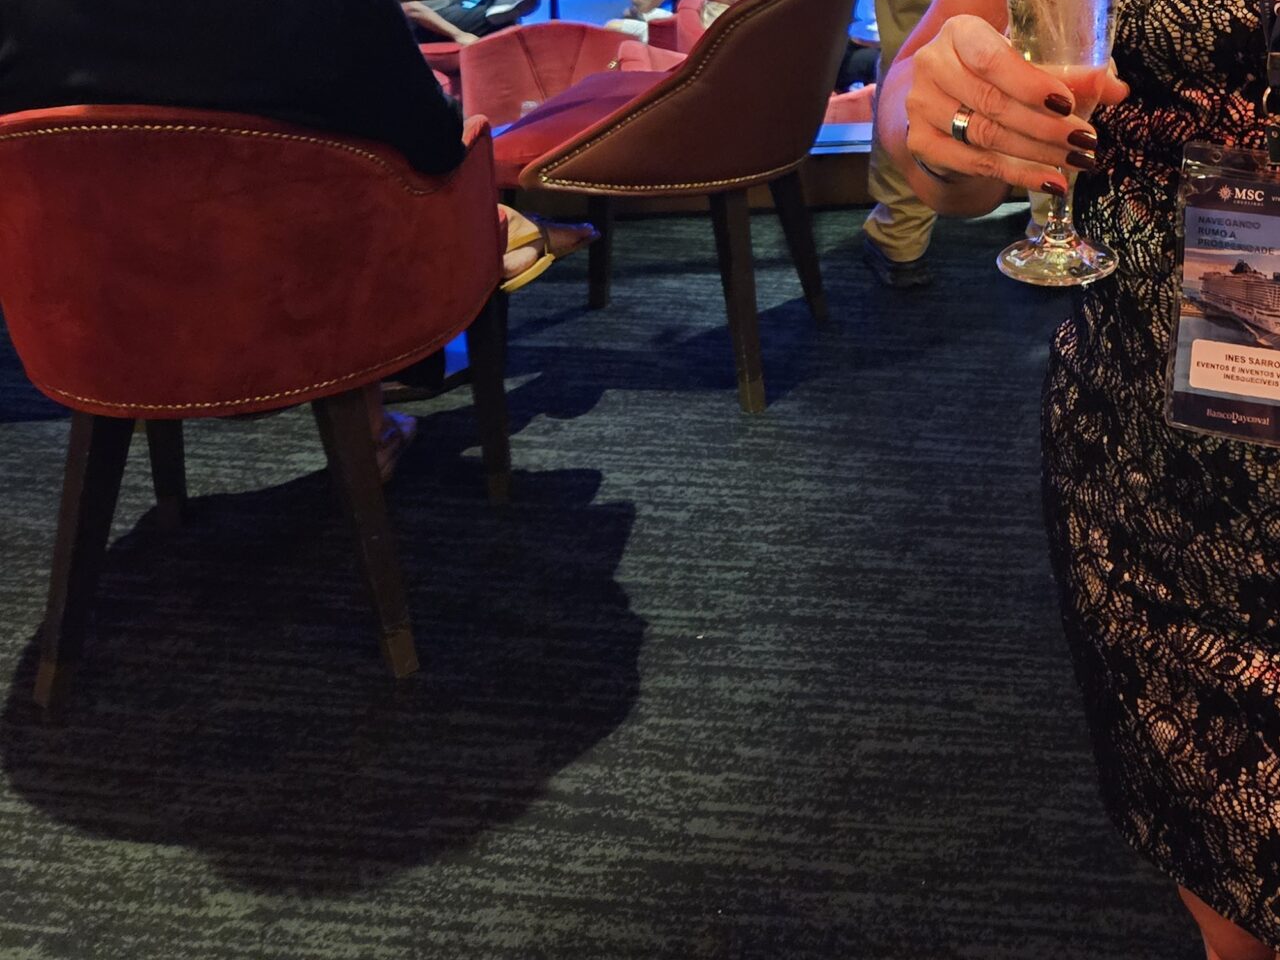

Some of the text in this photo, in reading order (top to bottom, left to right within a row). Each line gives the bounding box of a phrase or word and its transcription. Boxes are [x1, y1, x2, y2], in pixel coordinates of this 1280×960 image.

[1234, 187, 1265, 202] MSC
[1197, 215, 1262, 230] NAVEGANDO
[1197, 226, 1237, 240] RUMO A
[1225, 354, 1280, 369] INES SARRO
[1196, 361, 1230, 372] EVENTOS
[1238, 367, 1275, 378] INVENTOS
